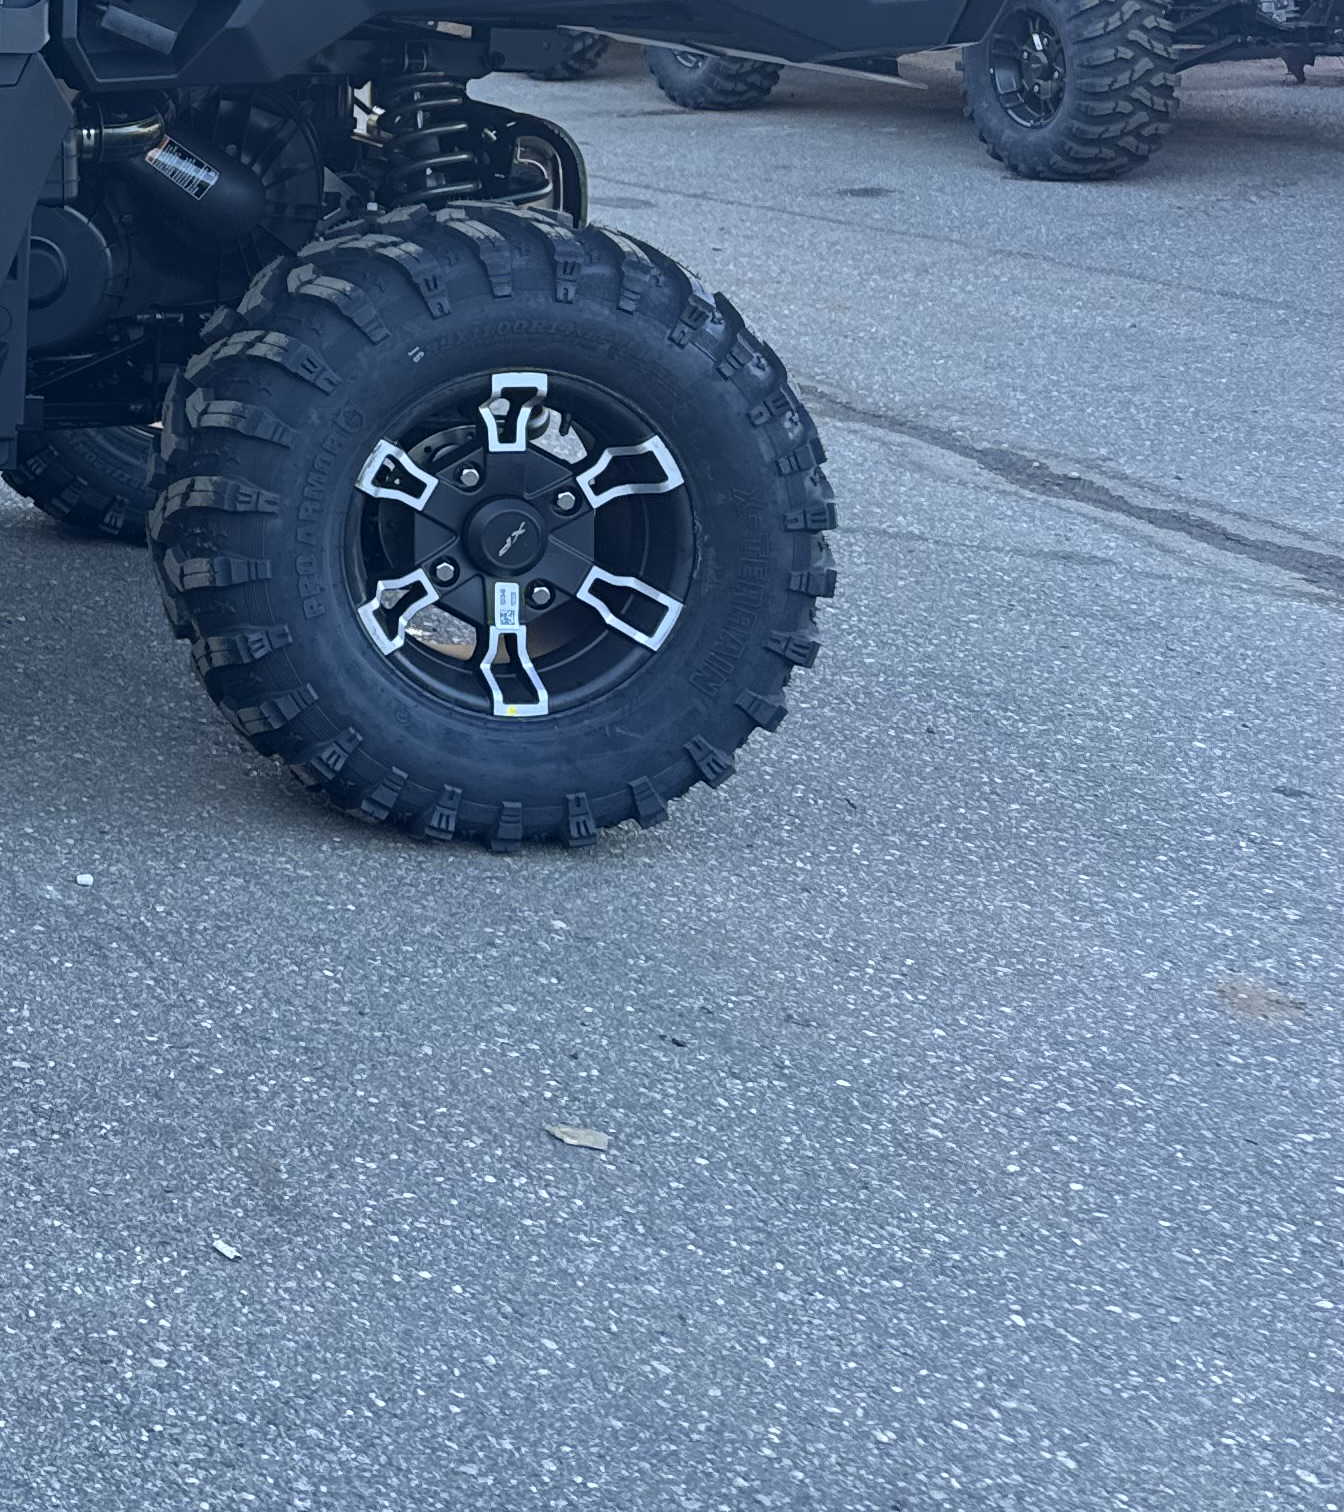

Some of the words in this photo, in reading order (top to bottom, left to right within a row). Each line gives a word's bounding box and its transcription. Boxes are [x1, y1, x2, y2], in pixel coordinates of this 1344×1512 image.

[294, 431, 350, 546] ARMOR
[498, 521, 526, 557] XP
[294, 552, 328, 621] PRO
[687, 486, 770, 699] X-TERRAIN
